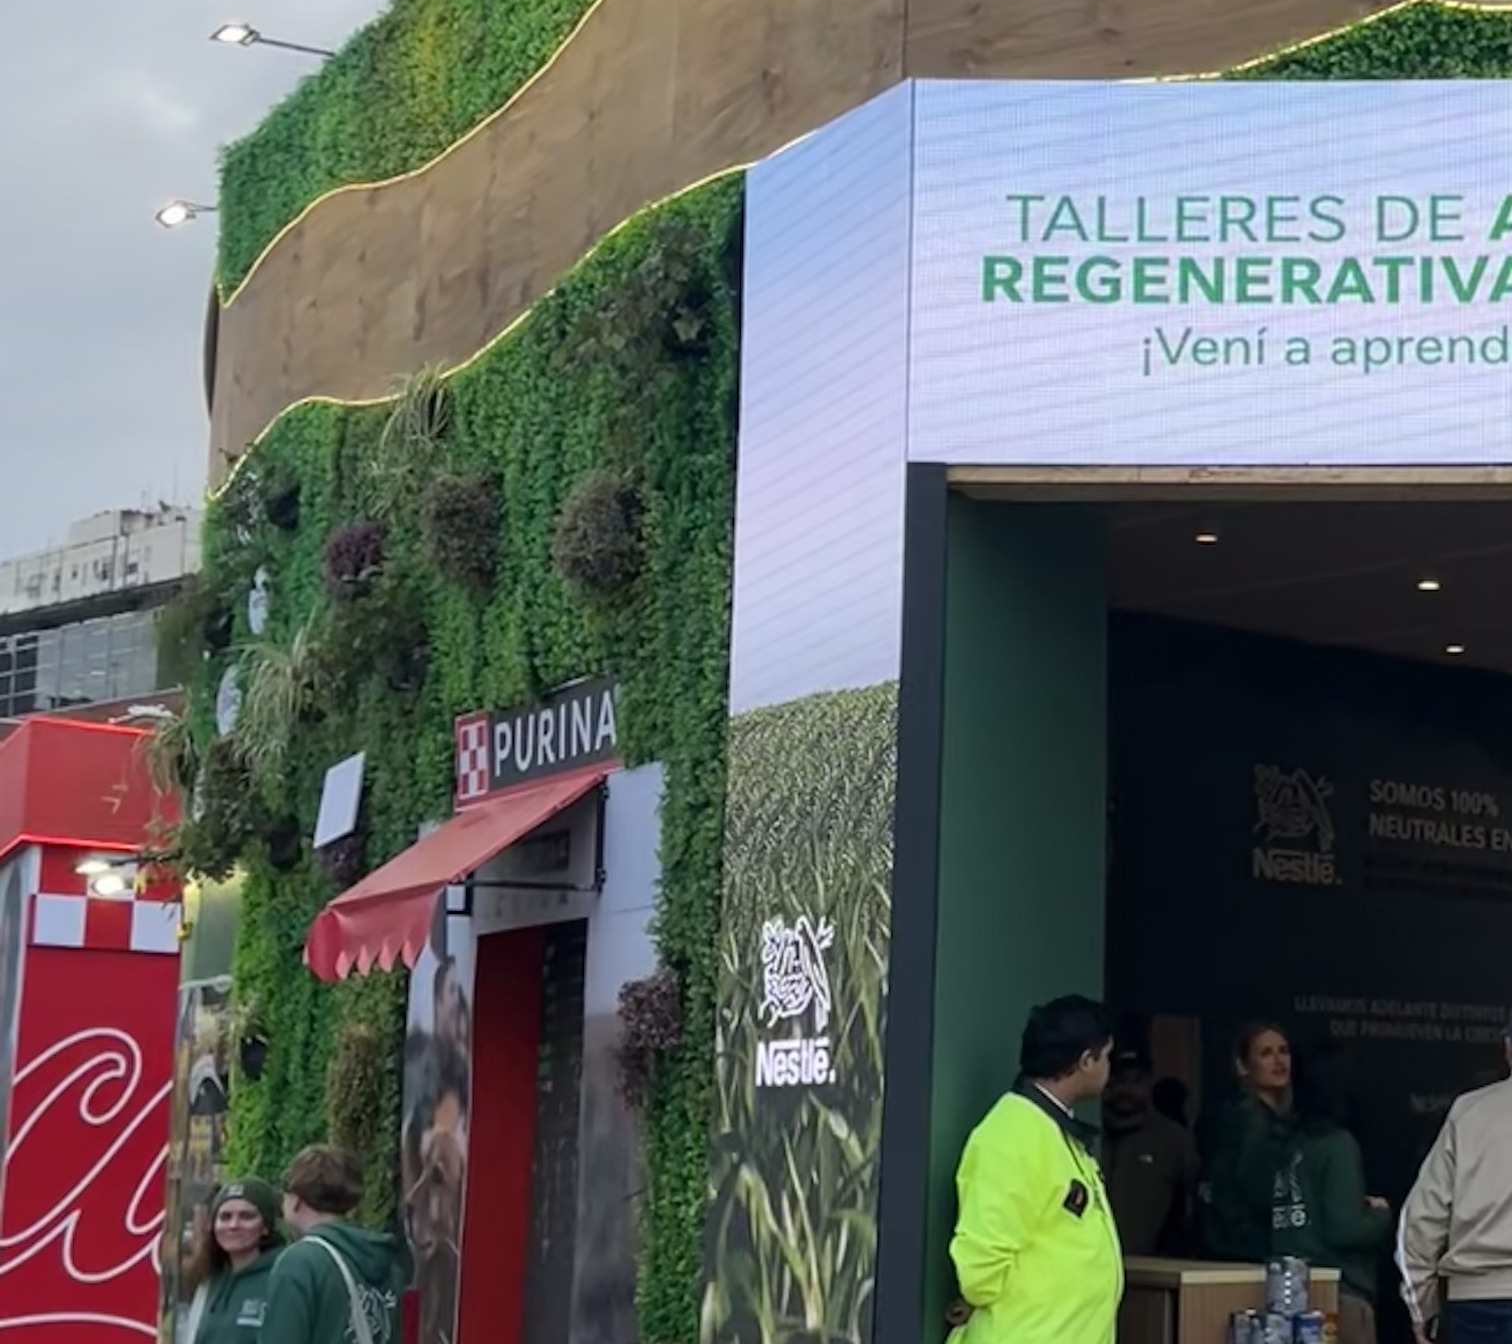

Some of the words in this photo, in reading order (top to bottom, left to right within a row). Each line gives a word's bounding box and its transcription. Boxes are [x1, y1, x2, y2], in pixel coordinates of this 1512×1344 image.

[1005, 194, 1347, 244] TALLERES
[1375, 194, 1465, 243] DE
[1142, 327, 1267, 376] ¡Vení
[1284, 336, 1311, 366] a
[493, 689, 618, 778] PURINA
[1368, 779, 1447, 811] SOMOS
[1450, 790, 1500, 817] 100%
[1368, 812, 1486, 850] NEUTRALES
